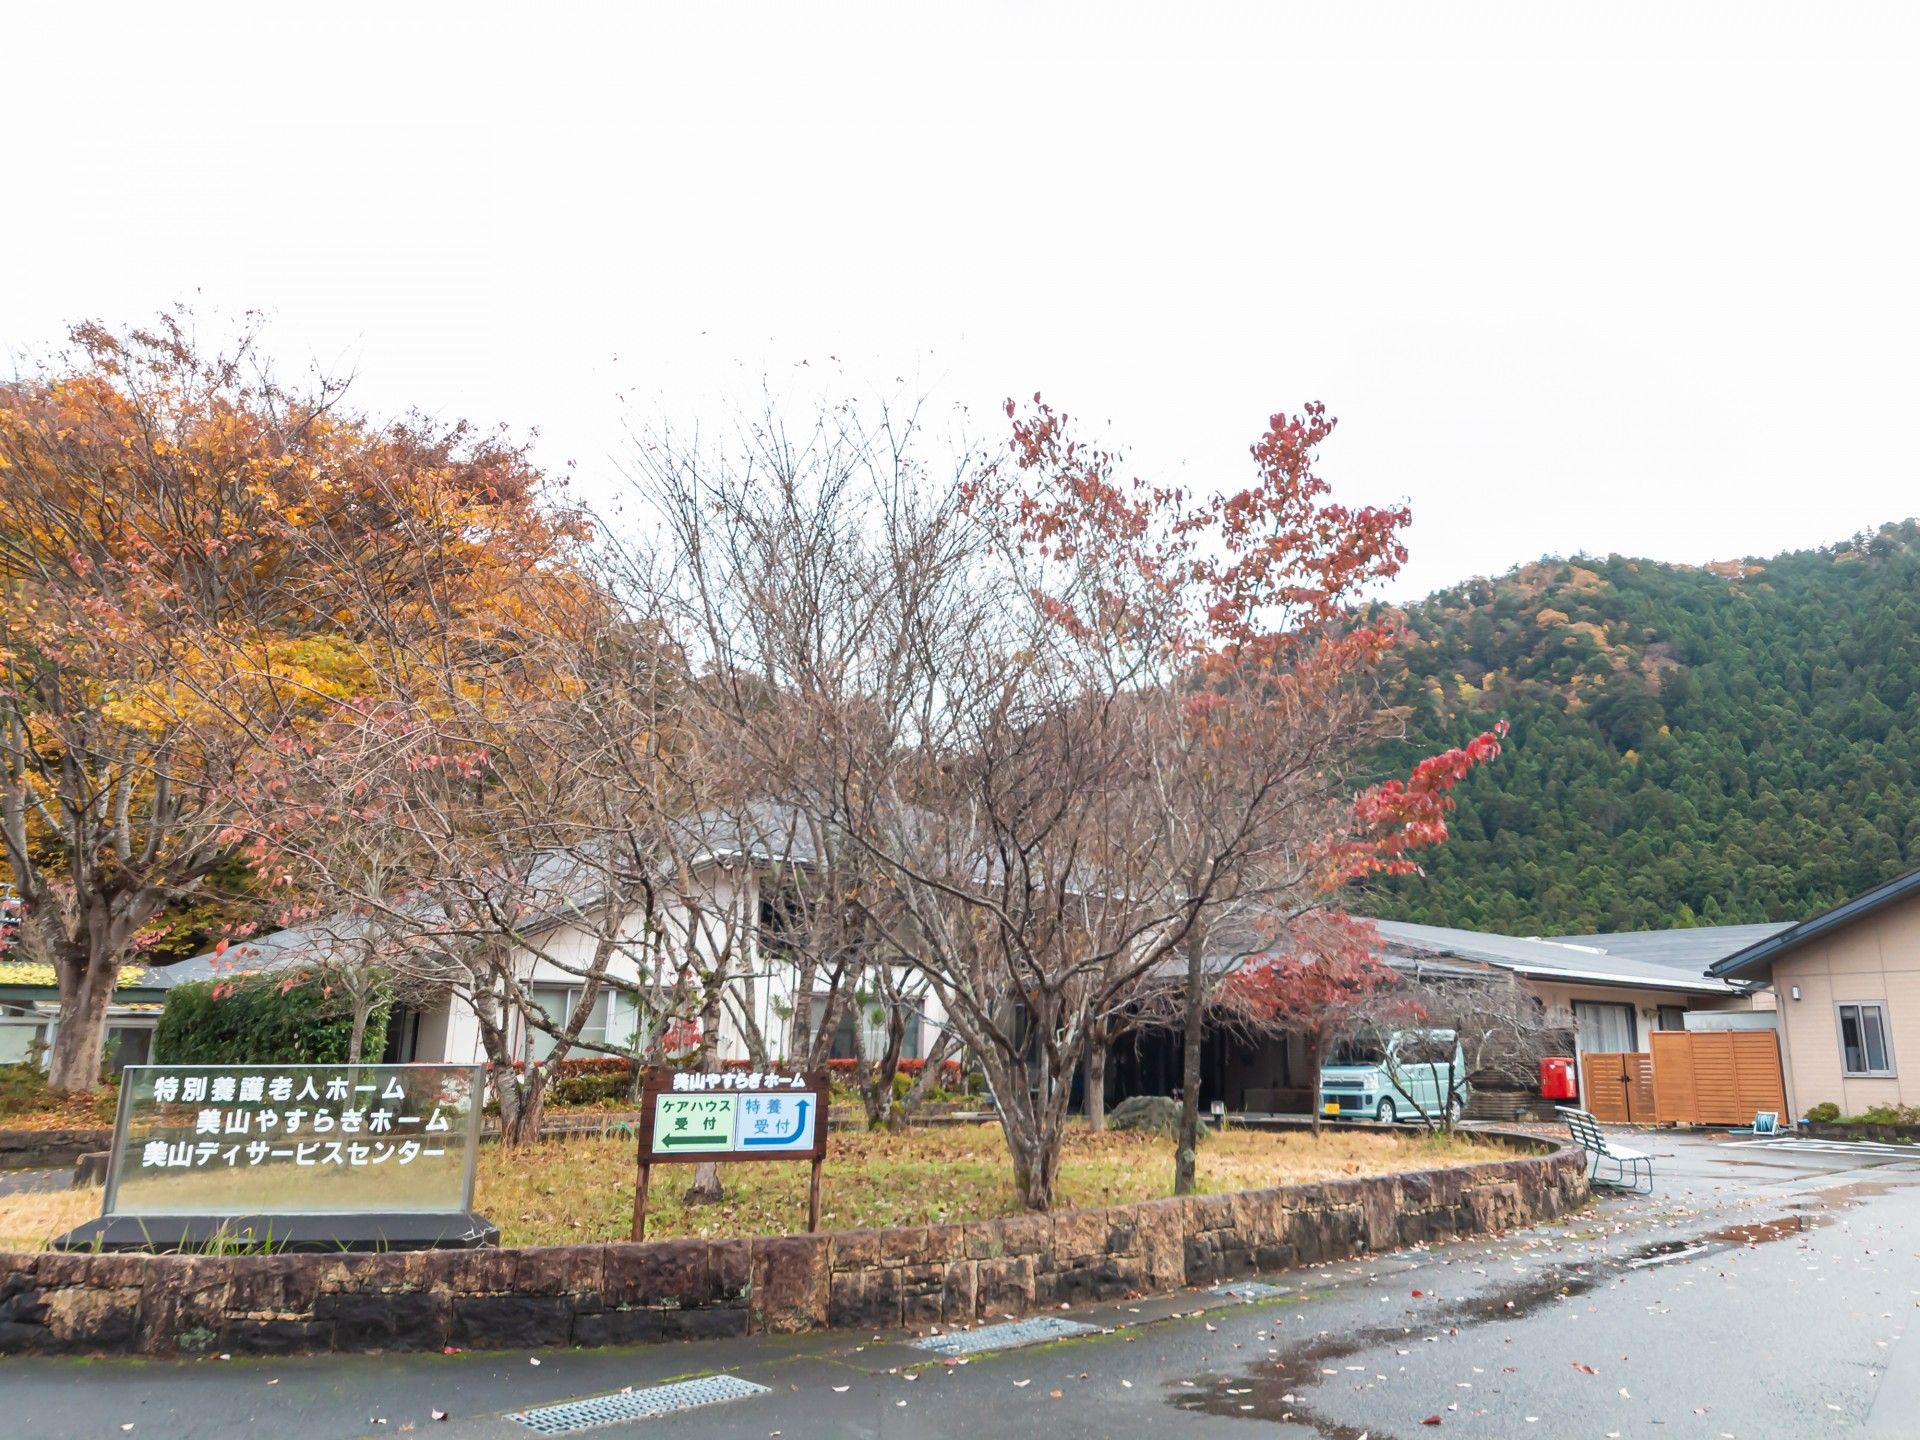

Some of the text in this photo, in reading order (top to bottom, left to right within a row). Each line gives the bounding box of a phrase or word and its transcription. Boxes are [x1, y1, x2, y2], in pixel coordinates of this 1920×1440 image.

[154, 1076, 405, 1102] 特別養護老人ホーム
[662, 1100, 731, 1114] ケアハウス
[745, 1098, 782, 1115] 特養
[195, 1108, 449, 1134] 美山やすらぎホーム
[675, 1116, 717, 1131] 受付
[754, 1119, 791, 1135] 受付
